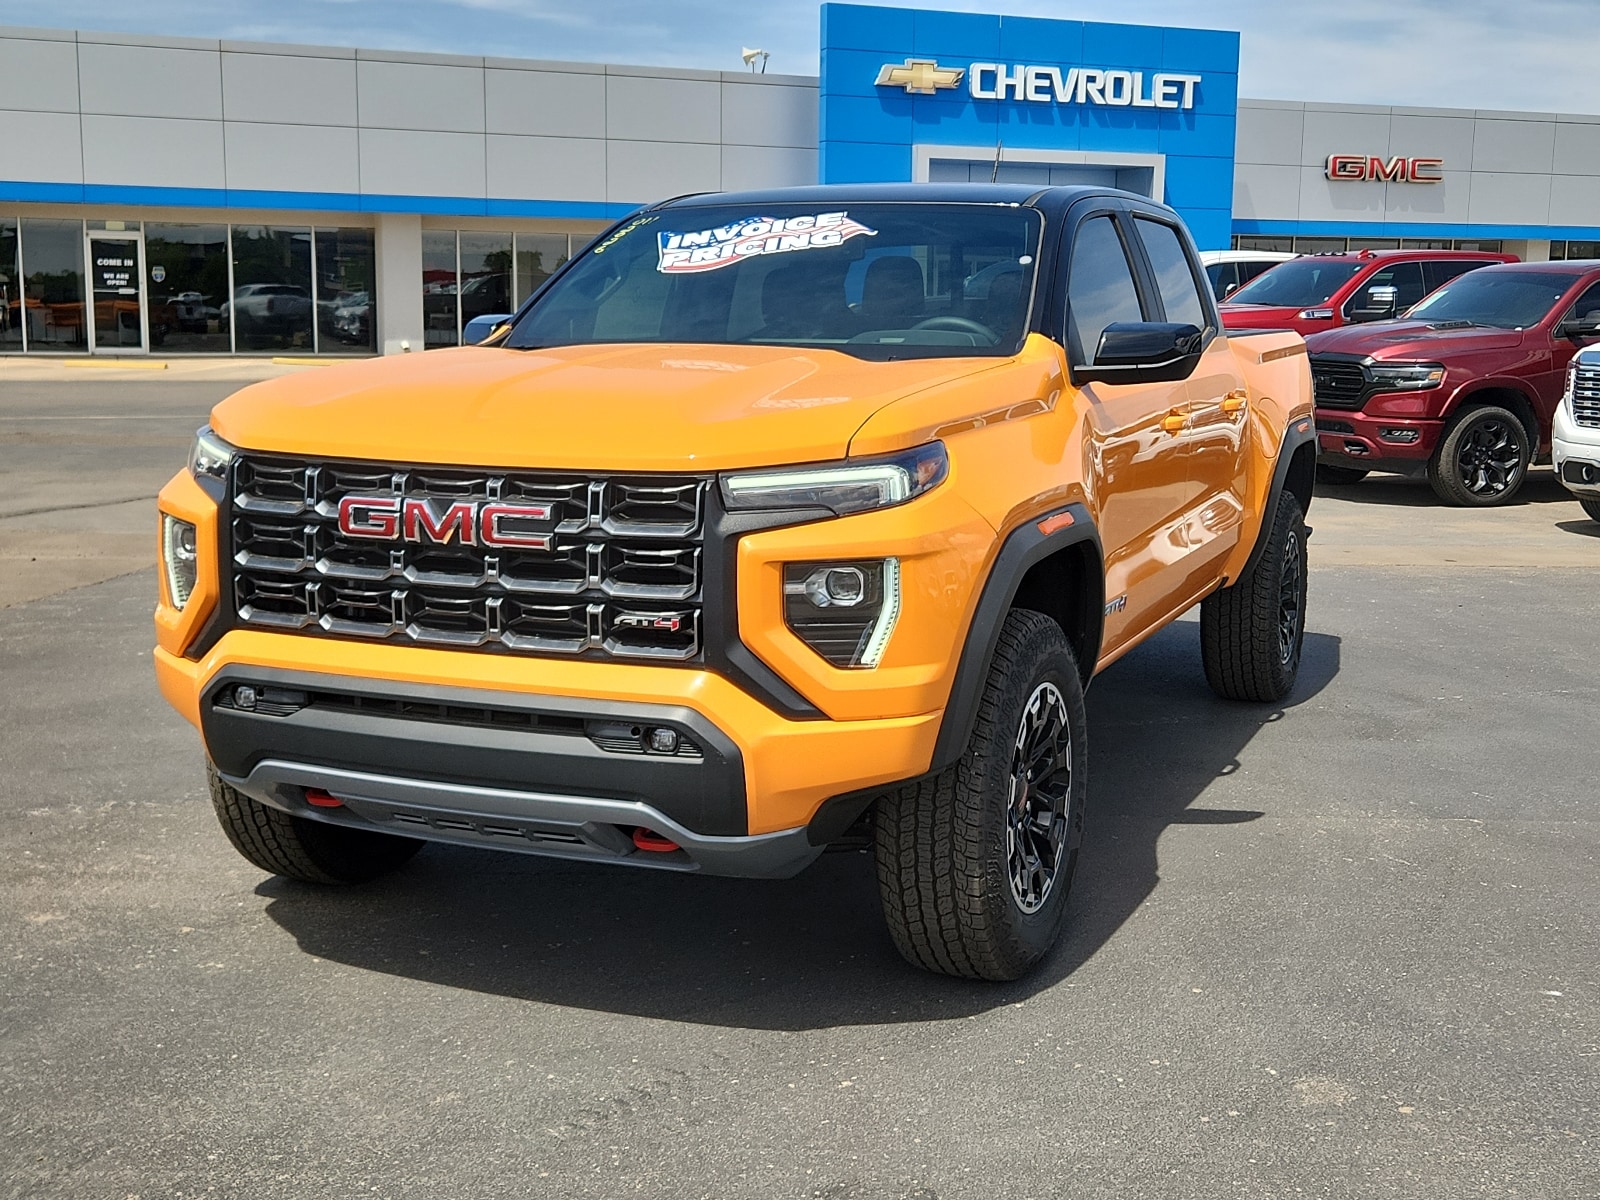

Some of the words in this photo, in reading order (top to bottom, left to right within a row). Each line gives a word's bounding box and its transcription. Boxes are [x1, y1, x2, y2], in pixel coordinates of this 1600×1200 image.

[970, 63, 1202, 110] CHEVROLET
[1326, 154, 1444, 183] GMC
[661, 230, 843, 268] PRICING
[666, 211, 848, 249] INVOICE
[97, 258, 122, 267] COME
[124, 259, 133, 267] IN
[338, 496, 553, 551] GMC
[614, 615, 680, 632] AT4
